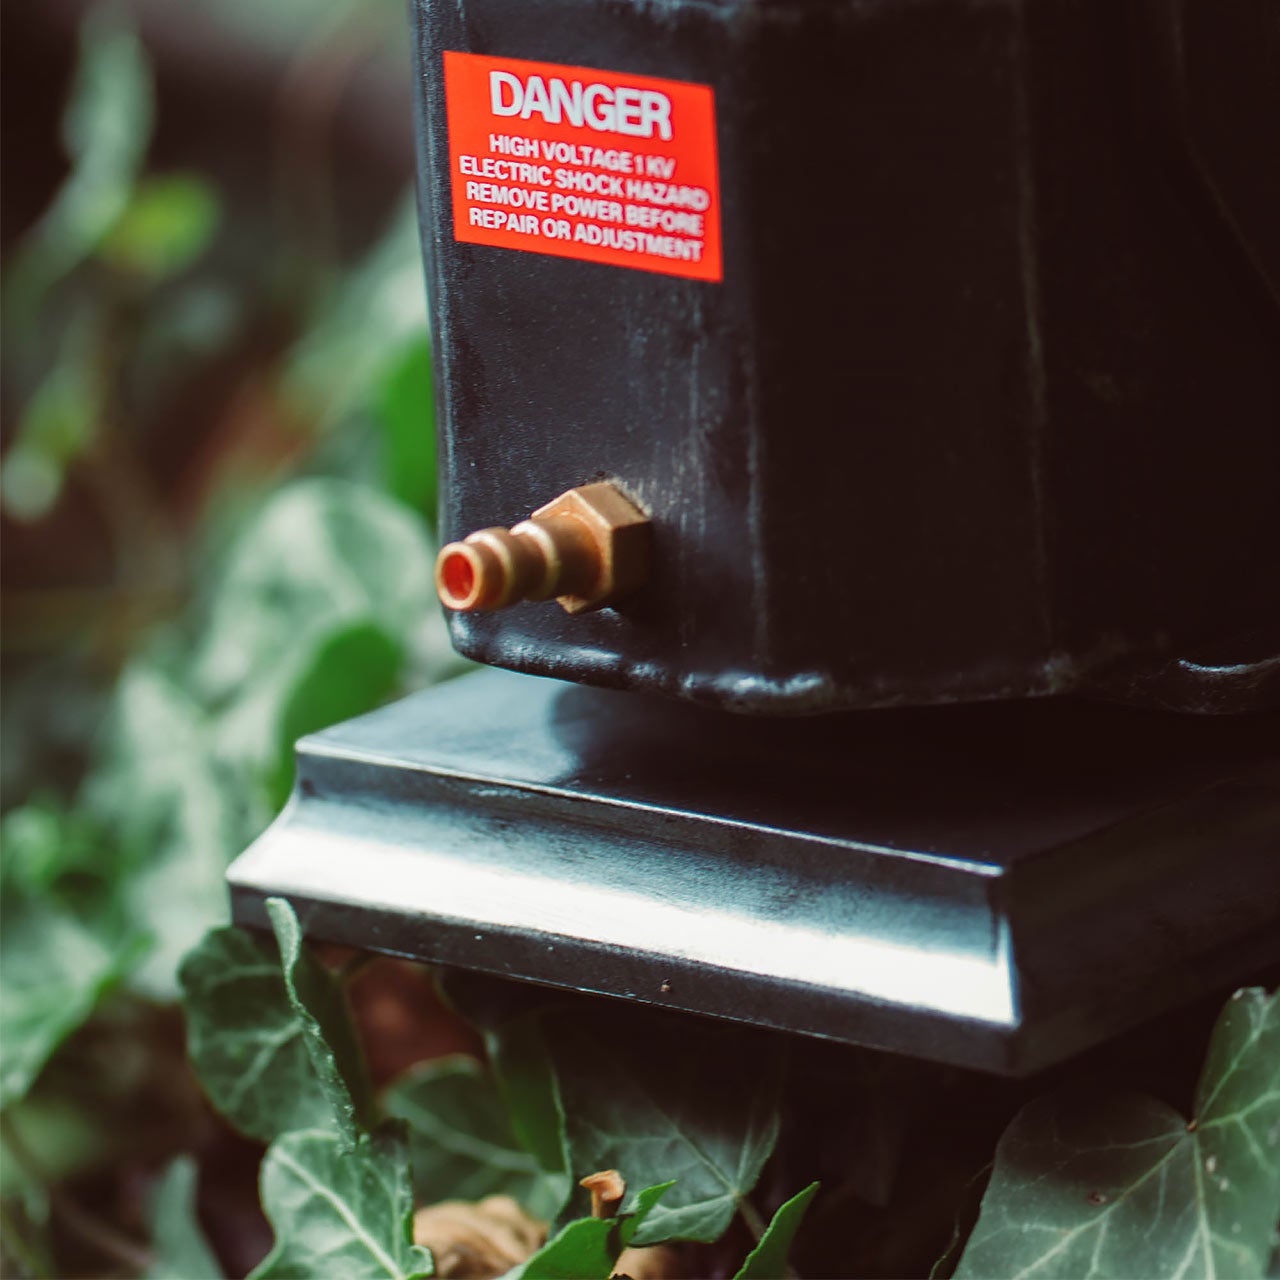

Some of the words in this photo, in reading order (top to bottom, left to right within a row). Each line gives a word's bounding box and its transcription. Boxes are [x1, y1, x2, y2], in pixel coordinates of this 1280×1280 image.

[489, 71, 673, 140] DANGER
[459, 156, 551, 187] ELECTRIC
[555, 169, 624, 198] SHOCK
[626, 180, 709, 211] HAZARD
[489, 134, 540, 158] HIGH
[542, 140, 633, 173] VOLTAGE
[646, 156, 676, 180] KV
[466, 182, 548, 211] REMOVE
[551, 194, 623, 221] POWER
[626, 204, 704, 237] BEFORE
[469, 207, 540, 235] REPAIR
[542, 218, 572, 239] OR
[574, 223, 704, 262] ADJUSTMENT
